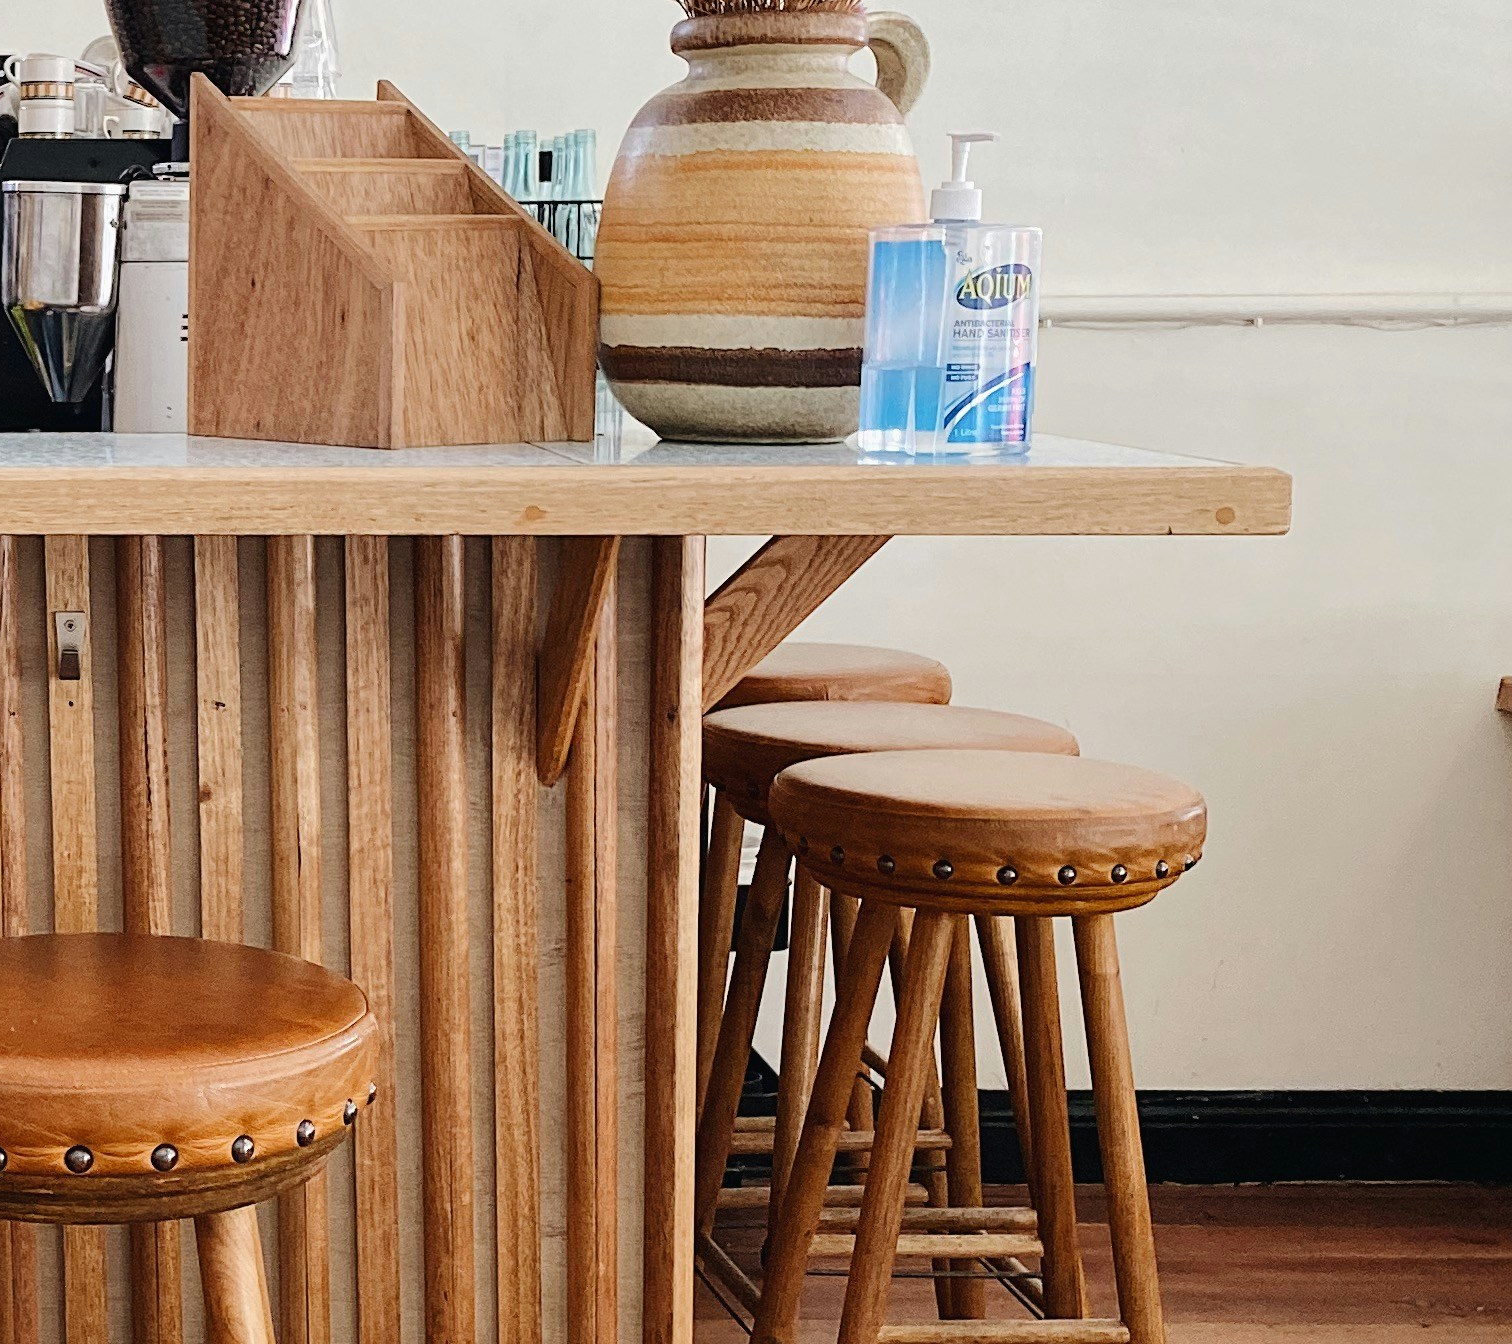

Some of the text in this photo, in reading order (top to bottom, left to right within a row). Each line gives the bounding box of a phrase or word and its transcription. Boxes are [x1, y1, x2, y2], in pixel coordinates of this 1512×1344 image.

[957, 267, 1032, 307] AQIUM
[953, 320, 1015, 328] ANTIBACTERIAL
[952, 328, 1031, 338] HAND SANITISER
